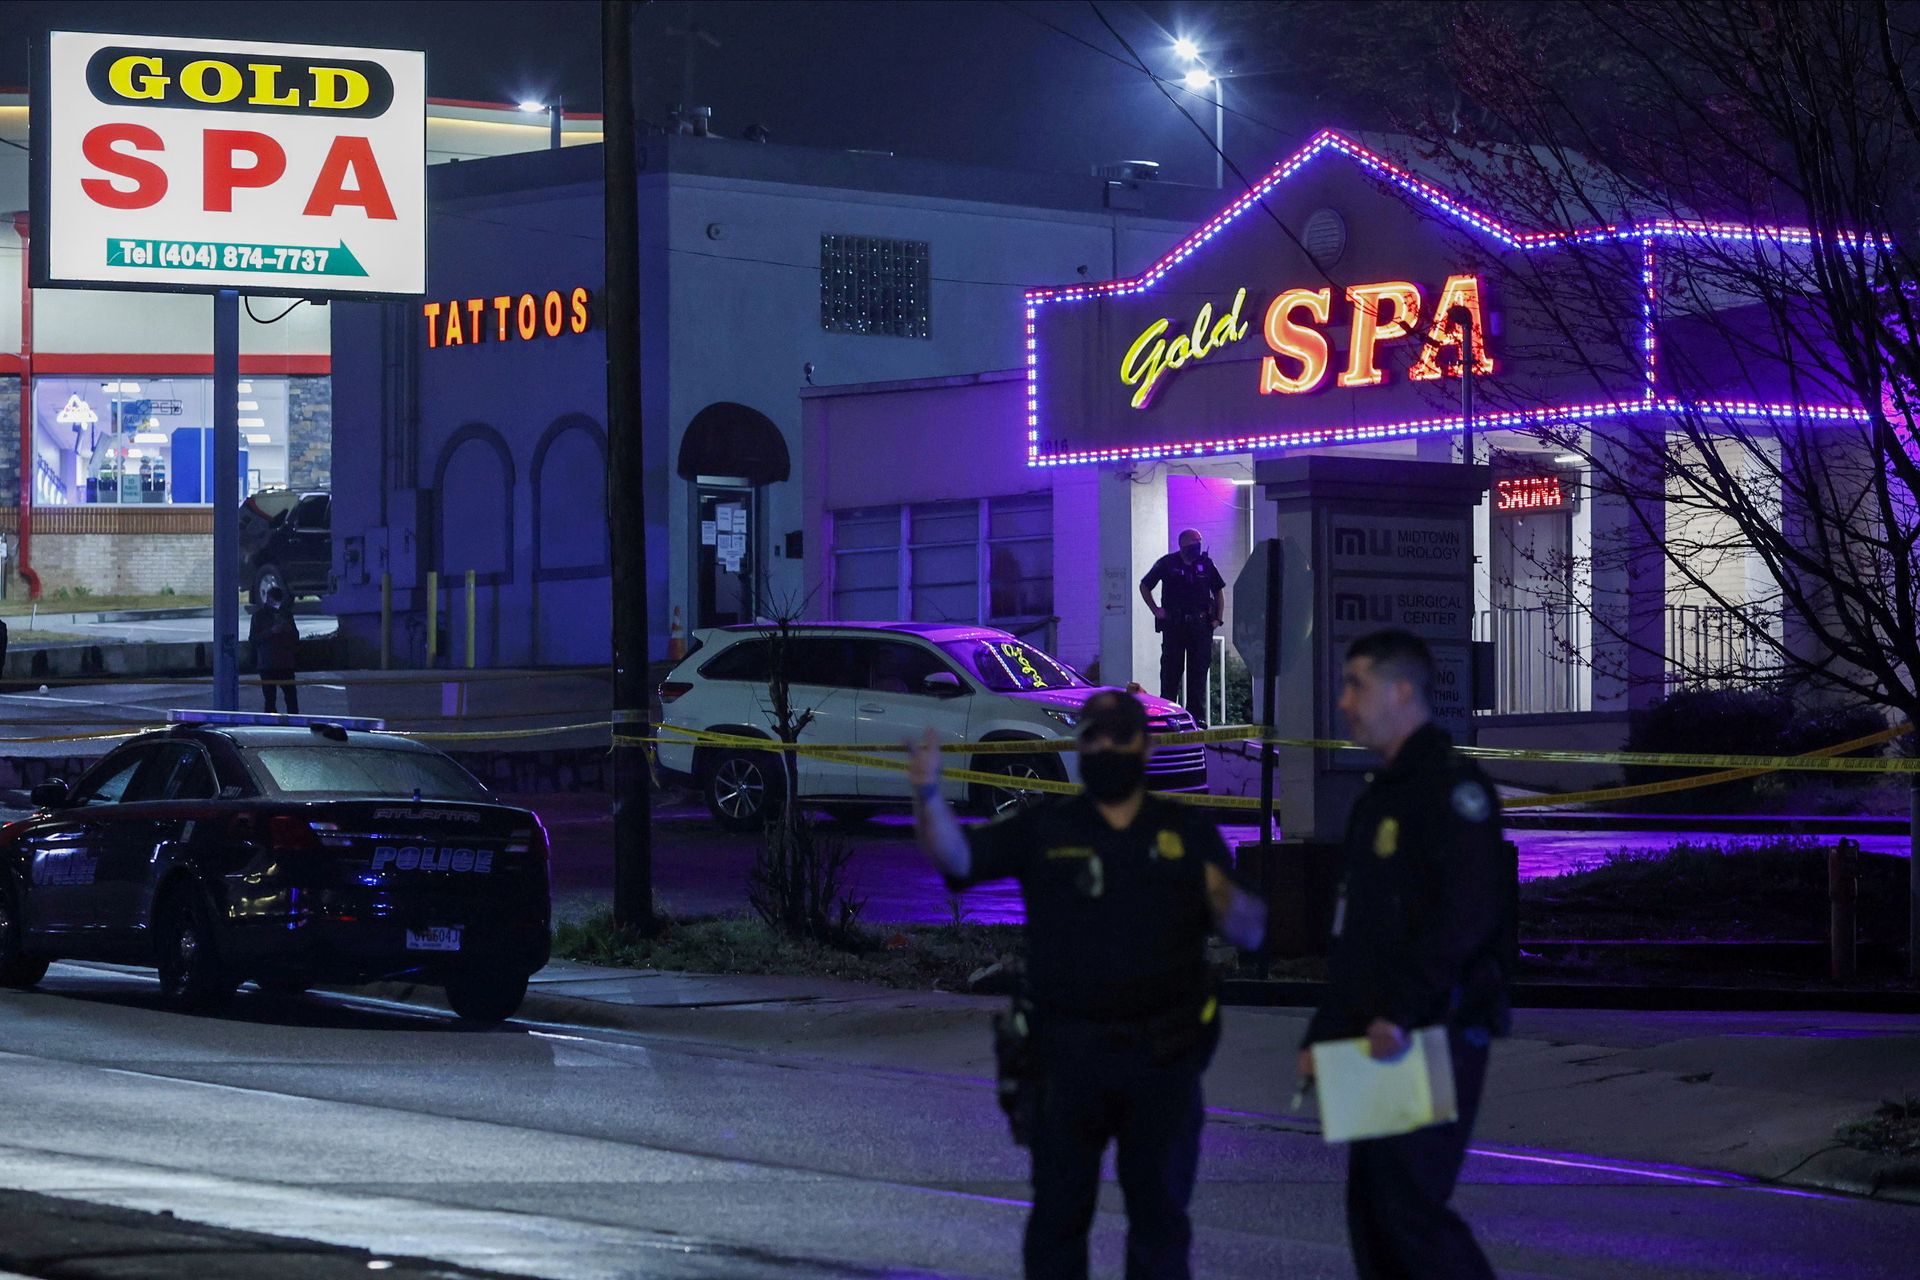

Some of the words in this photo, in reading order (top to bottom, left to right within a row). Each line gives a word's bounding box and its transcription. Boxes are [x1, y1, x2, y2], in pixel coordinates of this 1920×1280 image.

[107, 55, 370, 109] GOLD
[80, 122, 398, 221] SPA
[119, 240, 153, 265] Tel
[159, 243, 217, 269] (404)
[223, 246, 329, 272] 874-7737
[424, 287, 588, 348] TATTOOS
[1120, 286, 1249, 409] Gold
[1260, 274, 1494, 396] SPA
[1497, 477, 1561, 509] SAUNA
[1397, 530, 1460, 546] MIDTOWN
[1397, 546, 1461, 561] UROLOGY
[1397, 594, 1463, 609] SURGICAL
[1403, 611, 1457, 625] CENTER
[1438, 671, 1455, 685] NO
[1433, 690, 1460, 702] THRU
[1432, 706, 1466, 719] RAFFIC
[371, 846, 494, 873] POLICE
